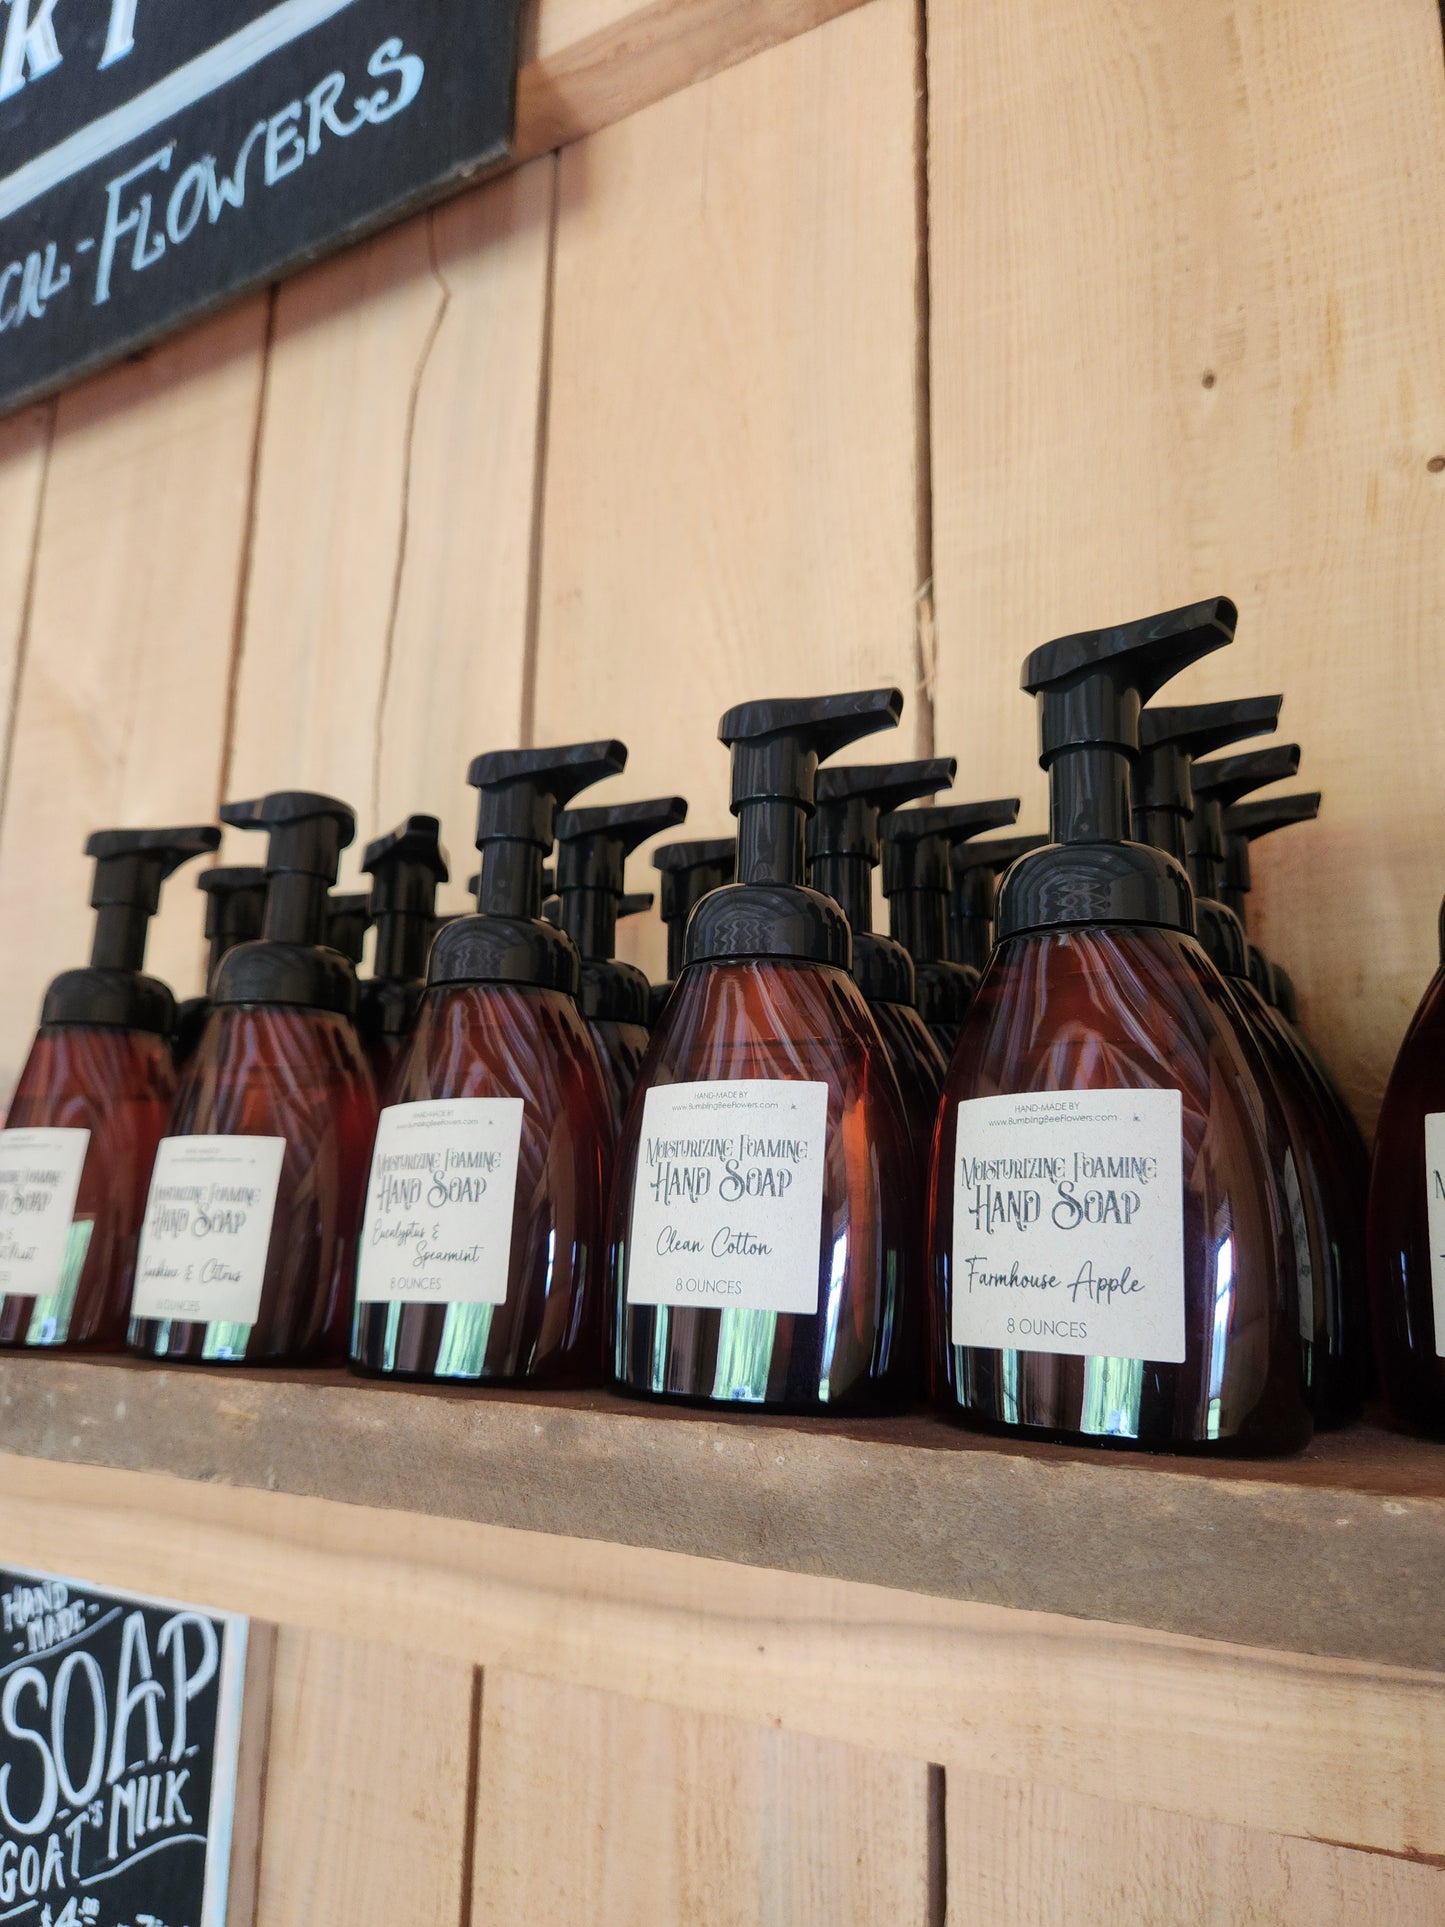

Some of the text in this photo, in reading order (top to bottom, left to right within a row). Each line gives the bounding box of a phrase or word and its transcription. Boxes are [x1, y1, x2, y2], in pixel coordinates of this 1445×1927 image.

[695, 1091, 748, 1100] HAND-MADE BY
[1014, 1101, 1080, 1113] HAND-MADE BY
[445, 1148, 502, 1173] FOAMING
[646, 1134, 808, 1166] MOISTURIZING FOAMING
[650, 1158, 793, 1206] HAND SOAP
[961, 1152, 1157, 1190] MOISTURIZING FOAMING
[376, 1169, 487, 1214] HAND SOAP
[968, 1180, 1141, 1235] HAND SOAP
[192, 1201, 247, 1238] SOAP
[372, 1218, 440, 1246] Eucalyptus &
[412, 1240, 485, 1269] Spearmint
[656, 1225, 773, 1258] Clean Cotton
[397, 1276, 442, 1290] OUNCES
[675, 1278, 742, 1295] 8 OUNCES
[965, 1255, 1146, 1305] Farmhouse Apple
[1006, 1317, 1088, 1339] 8 OUNCES
[1, 1611, 219, 1835] SOAP
[107, 1768, 193, 1861] MILK
